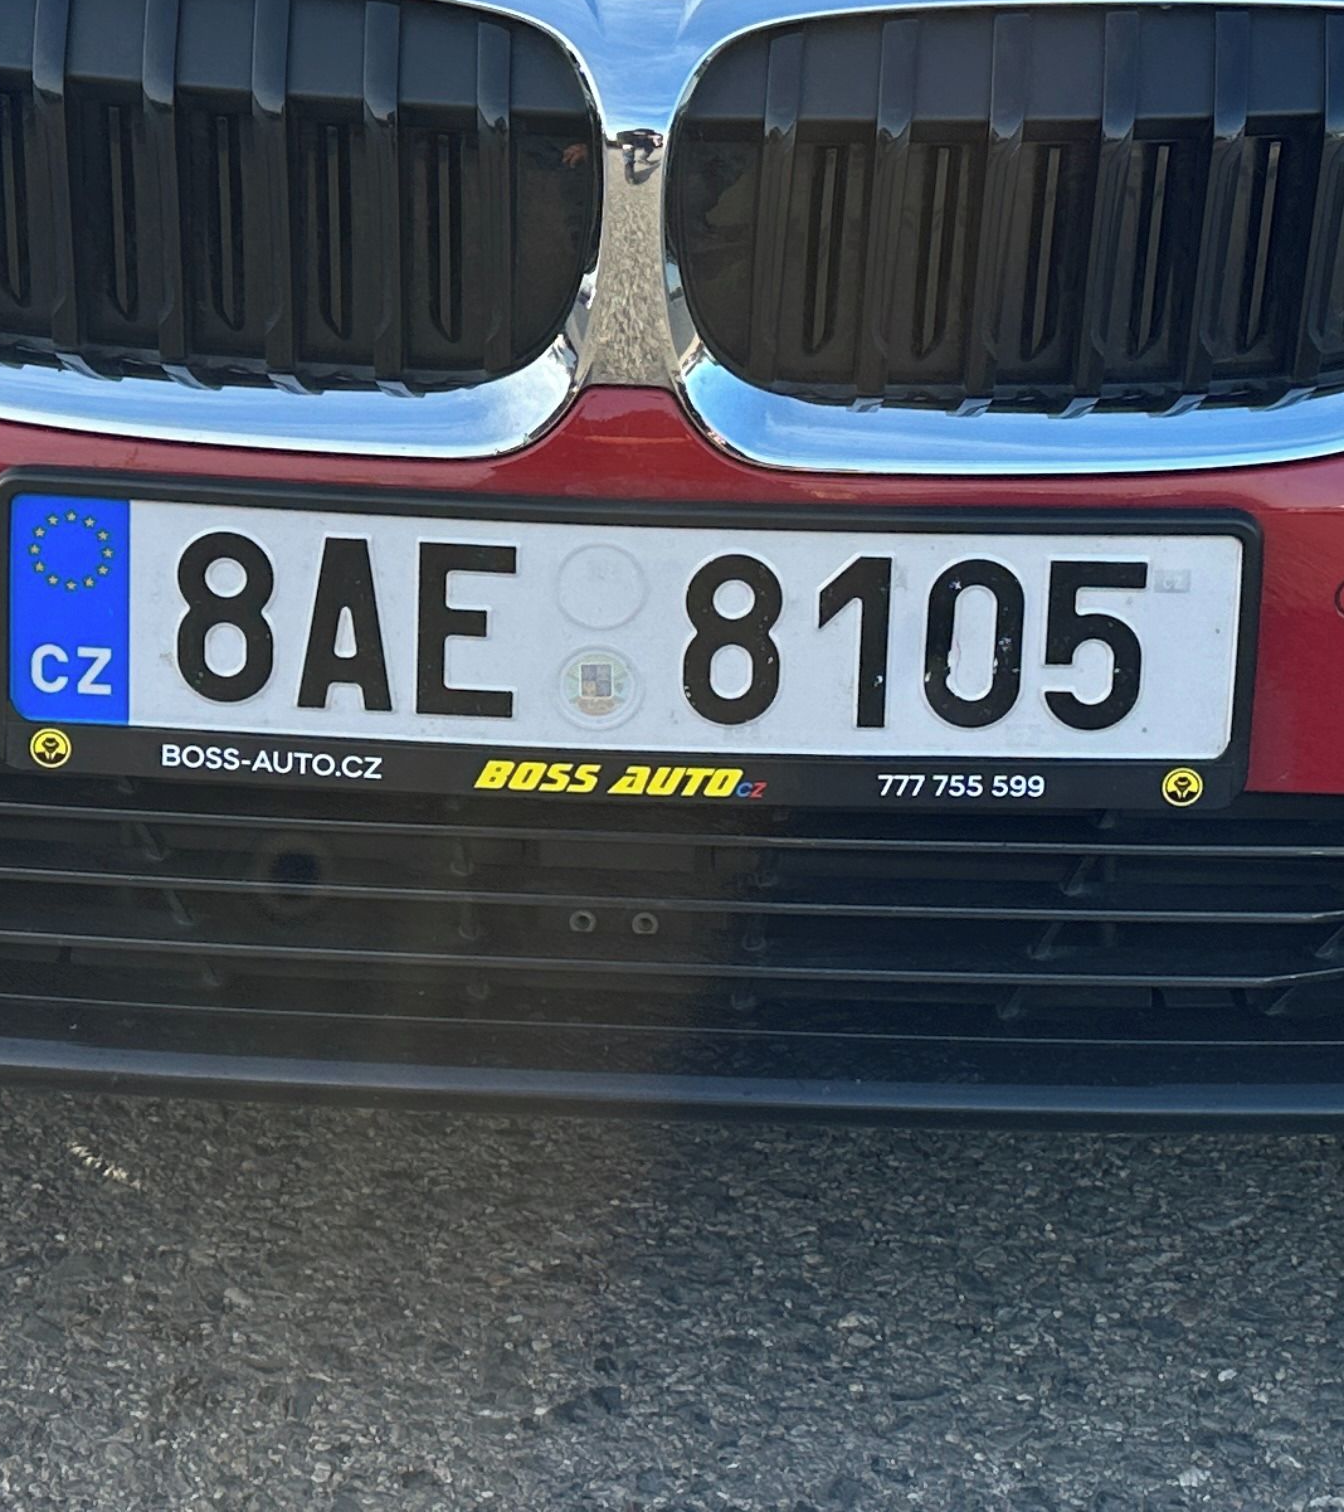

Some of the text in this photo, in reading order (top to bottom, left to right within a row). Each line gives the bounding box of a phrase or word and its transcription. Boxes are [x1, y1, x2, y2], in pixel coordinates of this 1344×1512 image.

[176, 531, 1149, 731] 8AE 8105
[31, 643, 112, 696] CZ
[161, 744, 383, 779] BOSS-AUTO.CZ
[474, 760, 602, 793] BOSS
[607, 765, 744, 797] AUTO
[877, 774, 1045, 798] 777 755 599
